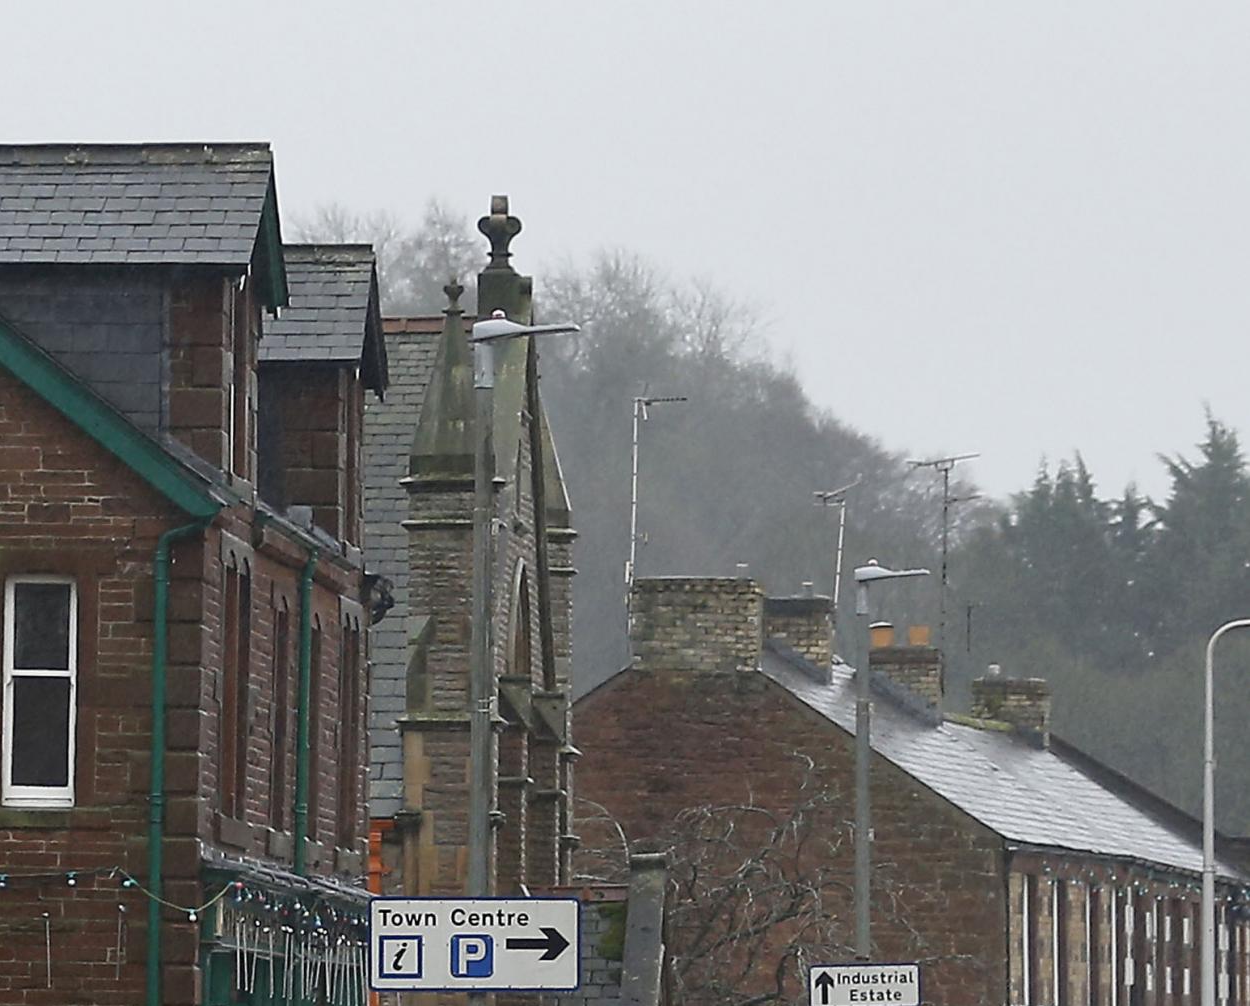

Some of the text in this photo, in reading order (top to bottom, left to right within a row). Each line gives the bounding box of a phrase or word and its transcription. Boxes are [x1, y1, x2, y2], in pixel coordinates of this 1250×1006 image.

[377, 908, 529, 927] Town Centre
[458, 939, 486, 974] P
[837, 971, 914, 985] Industrial
[849, 988, 902, 1002] Estate
